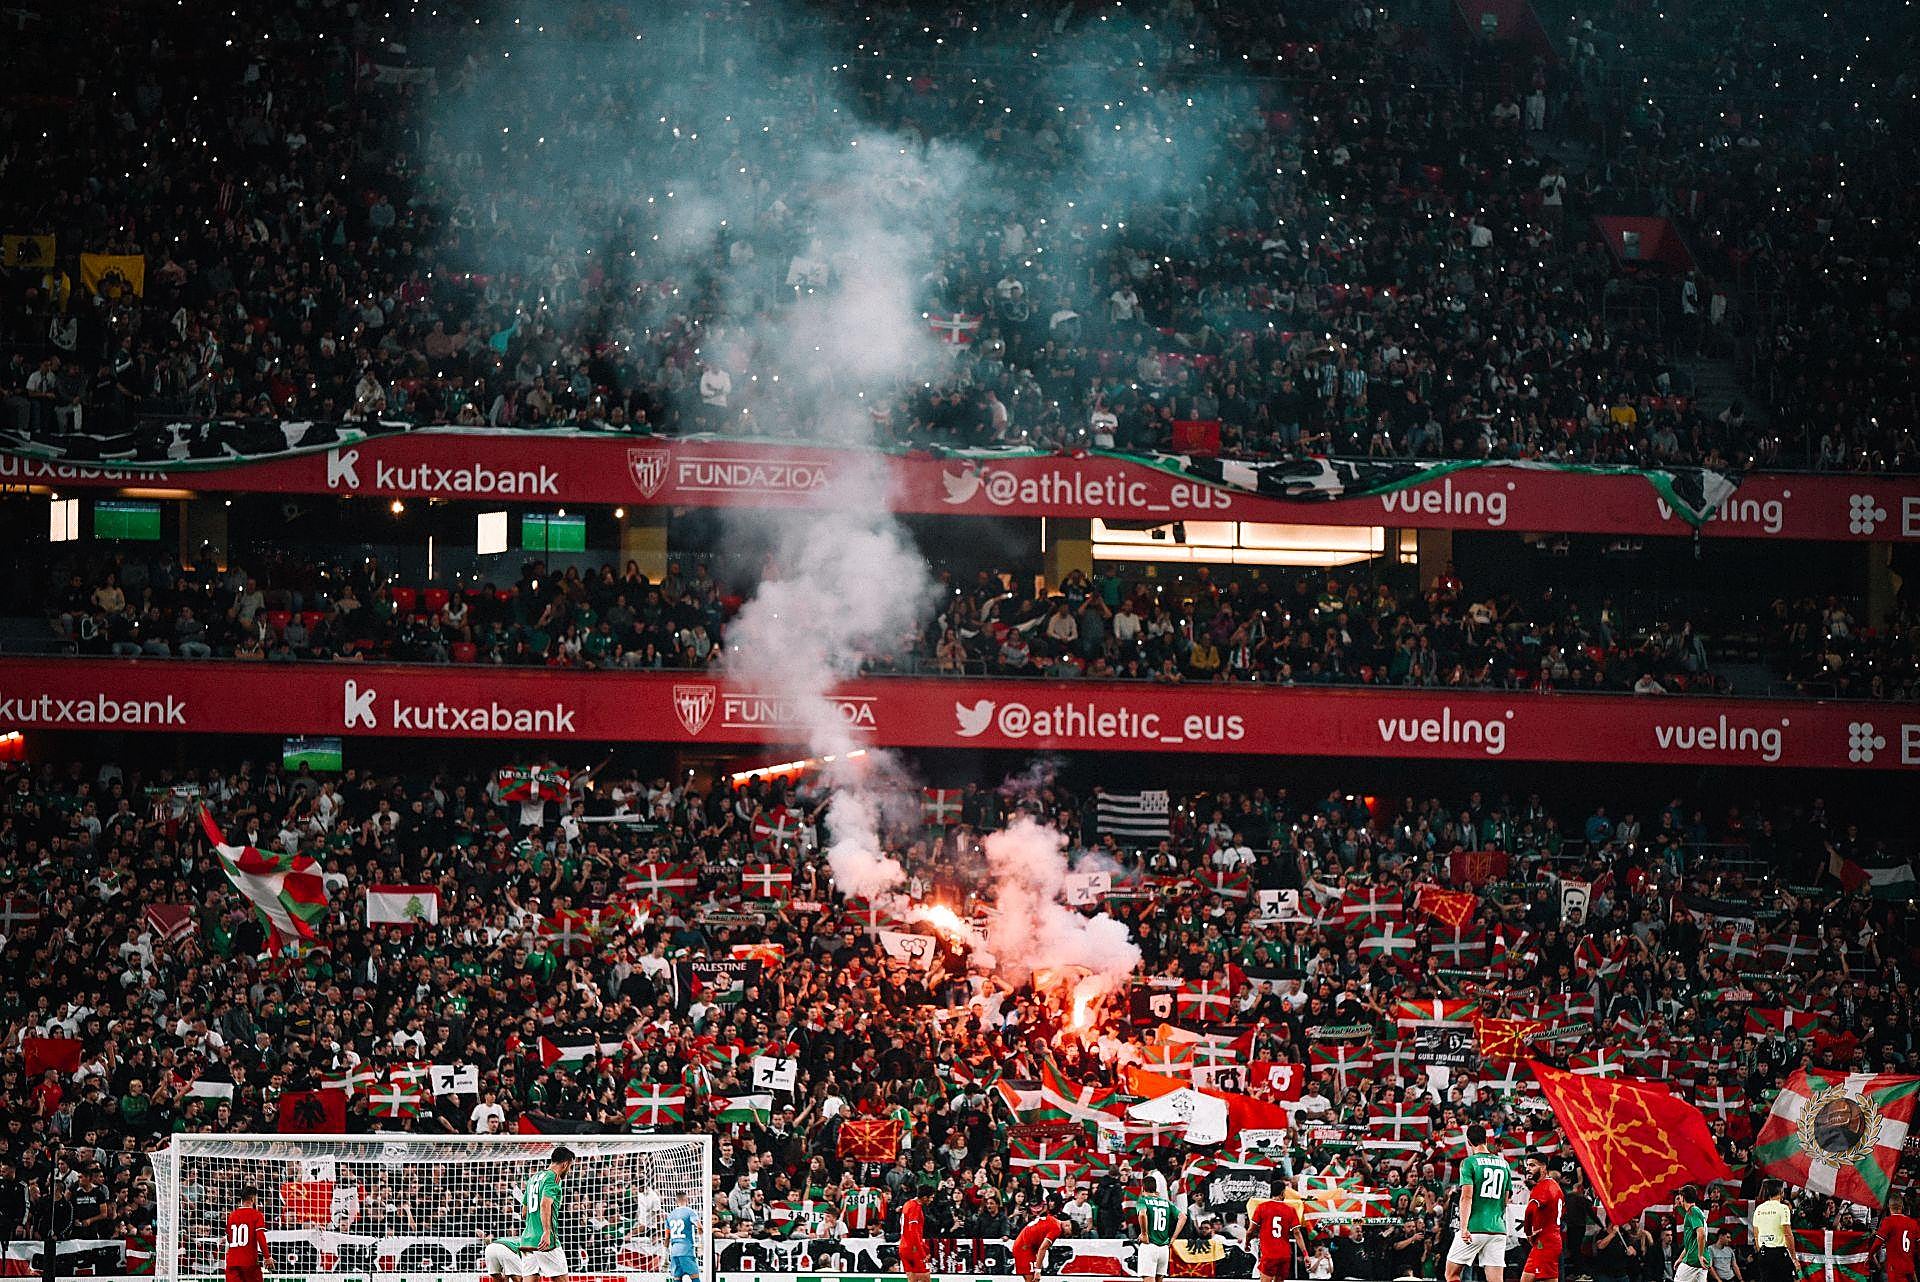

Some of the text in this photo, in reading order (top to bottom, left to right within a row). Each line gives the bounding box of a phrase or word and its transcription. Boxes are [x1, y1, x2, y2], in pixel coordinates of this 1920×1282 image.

[376, 459, 559, 495] kutxabank
[679, 463, 830, 489] FUNDAZIOA
[985, 471, 1233, 511] @athletic_eus
[1380, 478, 1507, 526] vueling
[0, 694, 185, 724] kutxabank
[393, 700, 576, 733] kutxabank
[998, 703, 1244, 743] @athletic_eus
[1378, 707, 1506, 755] vueling
[1655, 715, 1782, 761] vueling
[691, 962, 747, 972] PALESTINE
[1480, 1167, 1505, 1200] 20
[847, 1193, 876, 1205] 48015
[669, 1219, 687, 1238] 22
[1153, 1206, 1166, 1231] 16
[1272, 1216, 1282, 1239] 5
[229, 1223, 249, 1248] 10
[1902, 1230, 1911, 1252] 6
